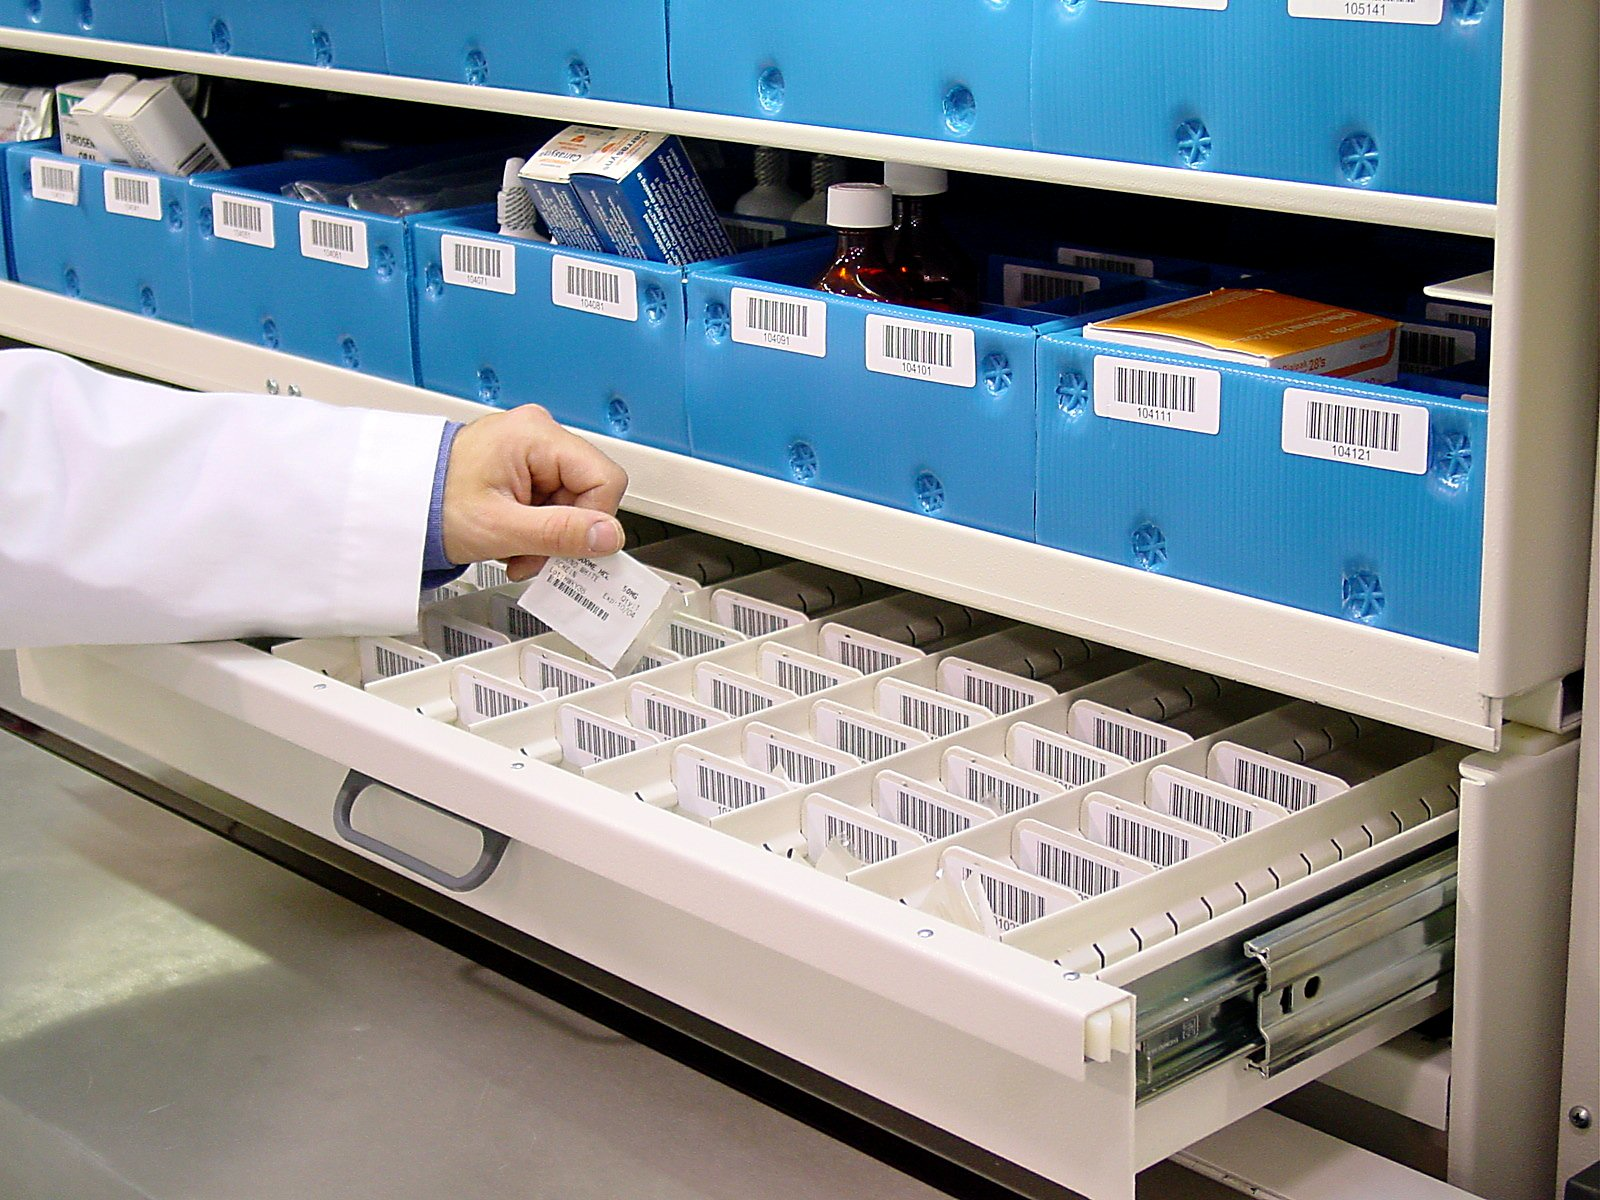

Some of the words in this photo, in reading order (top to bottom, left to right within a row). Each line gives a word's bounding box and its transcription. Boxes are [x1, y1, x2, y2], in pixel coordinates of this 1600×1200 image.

[1344, 2, 1386, 16] 105141
[466, 275, 488, 287] 104071
[581, 298, 604, 311] 104081
[763, 332, 790, 346] 104091
[902, 362, 932, 376] 104101
[1137, 407, 1172, 423] 104111
[1331, 445, 1371, 462] 104121
